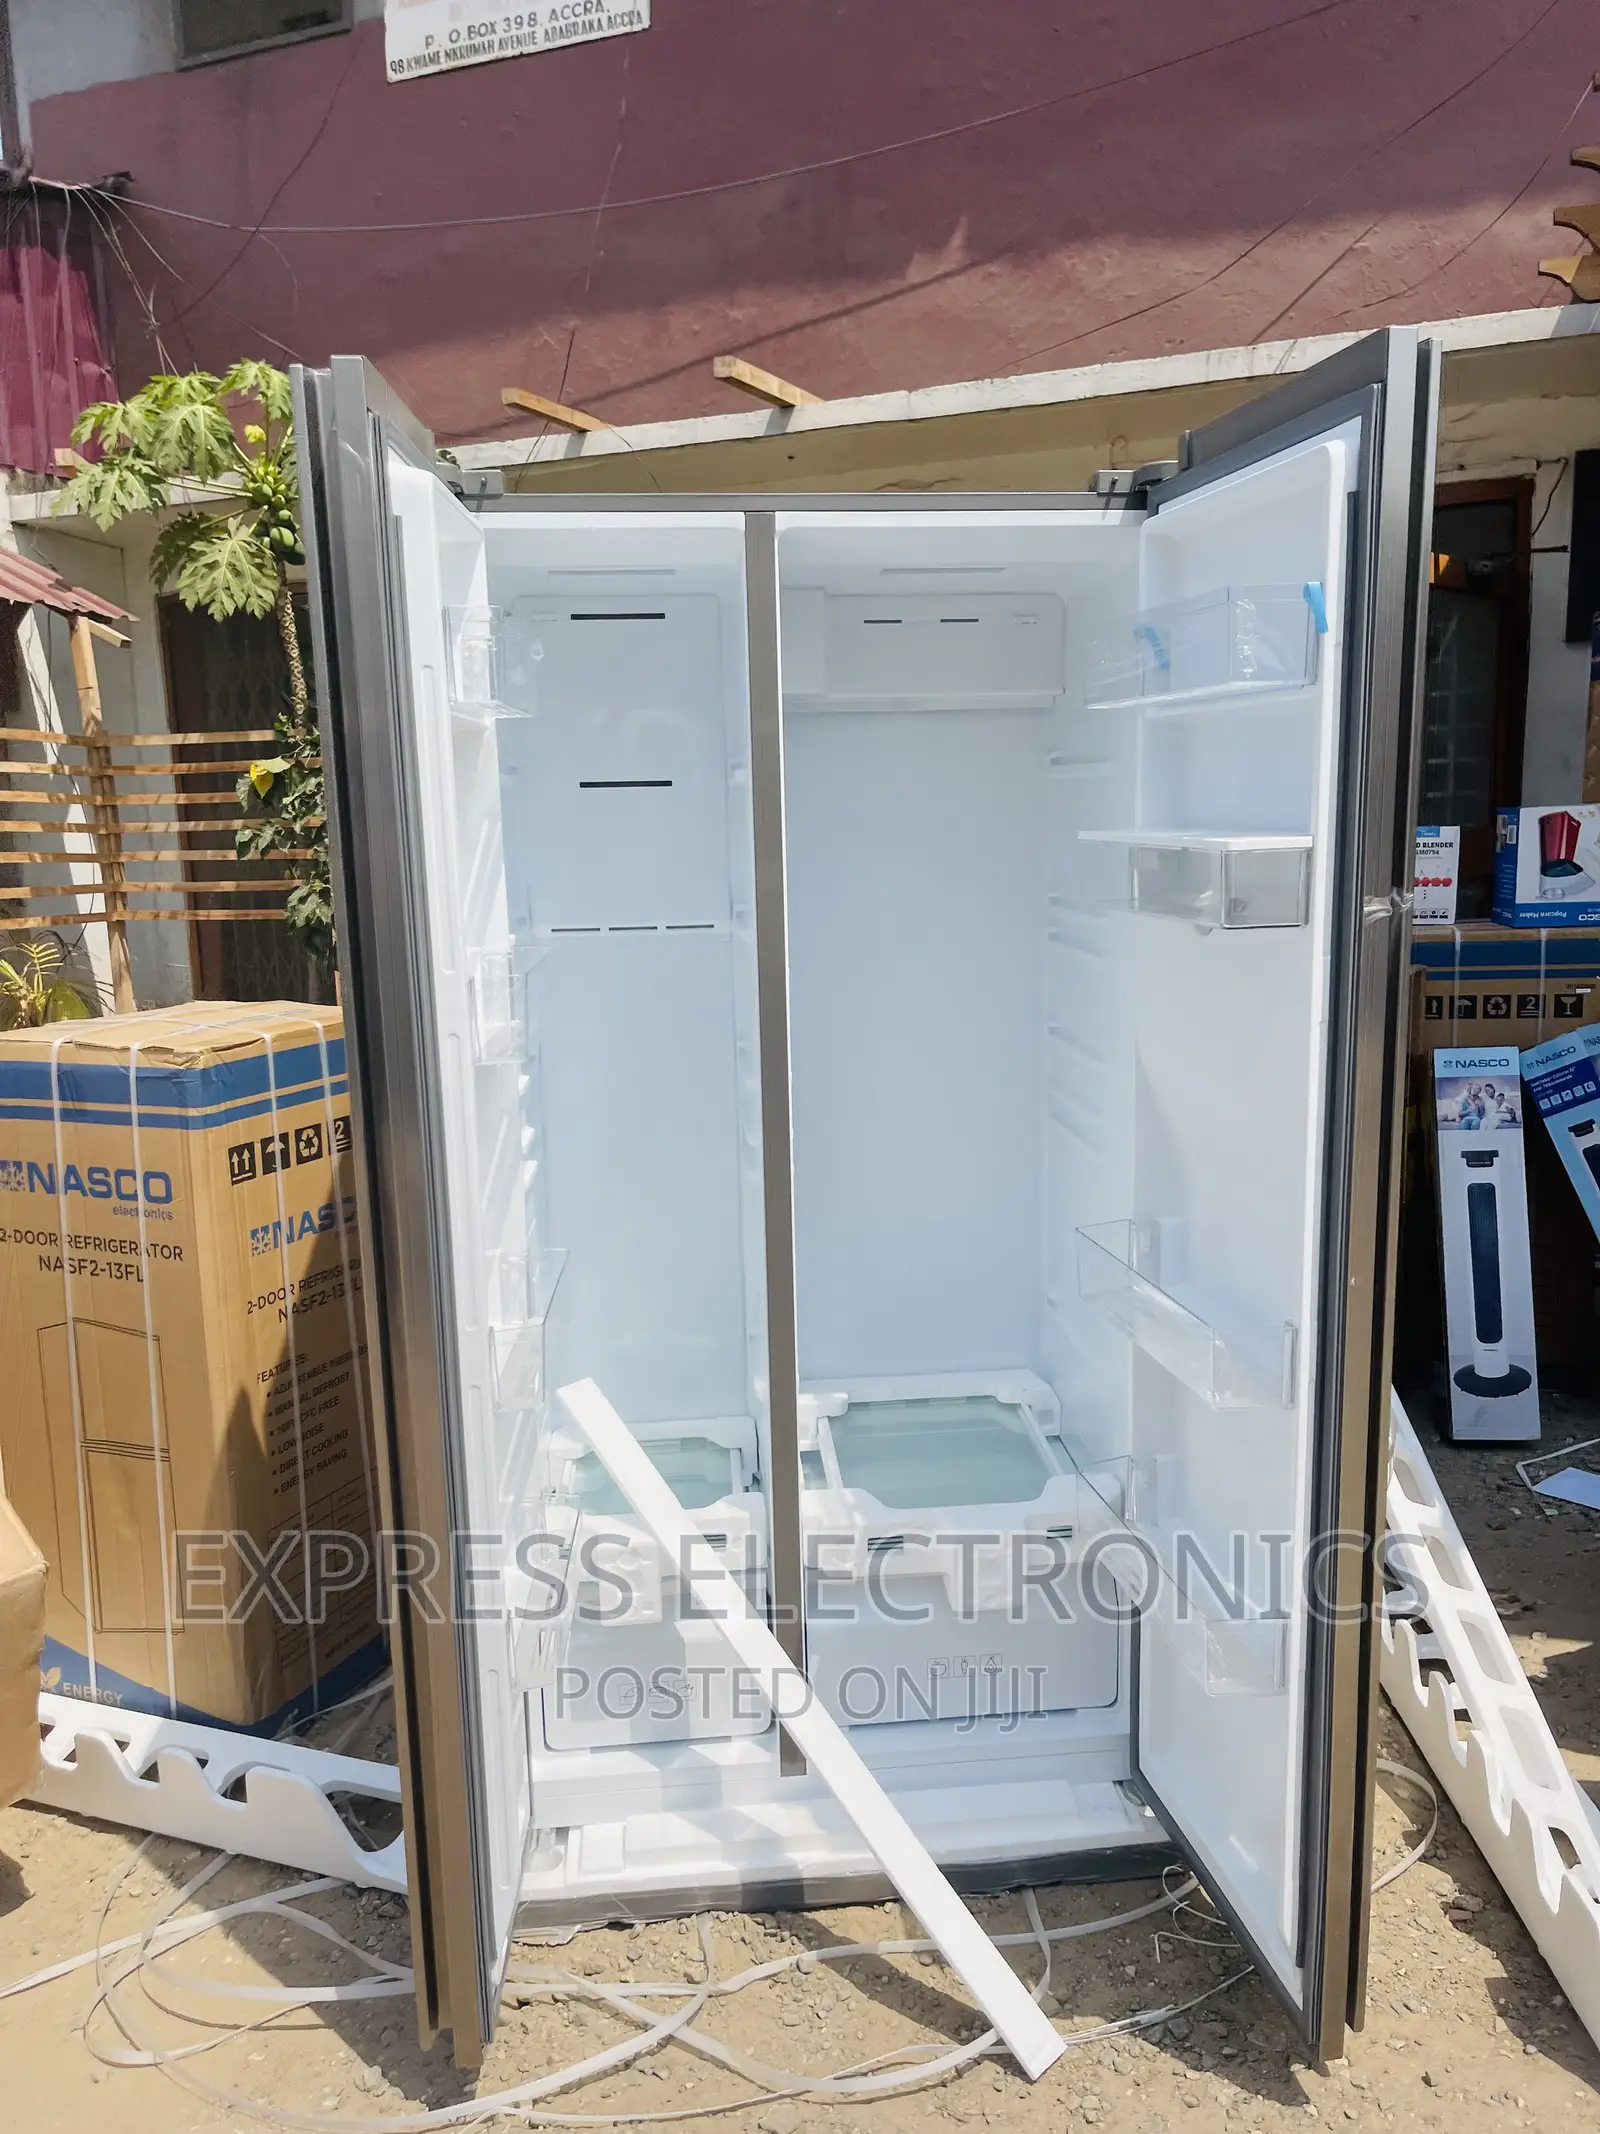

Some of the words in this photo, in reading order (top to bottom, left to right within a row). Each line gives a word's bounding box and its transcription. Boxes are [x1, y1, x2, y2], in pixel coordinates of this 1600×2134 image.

[390, 58, 406, 76] 98
[406, 51, 442, 73] KWAME
[444, 38, 496, 65] NKRUMAH
[497, 31, 539, 53] AVENUE
[543, 17, 605, 45] ADABRAKA
[606, 9, 644, 32] ACCRA
[1455, 1058, 1510, 1069] NASCO
[1535, 1046, 1577, 1067] NASCO
[26, 1161, 173, 1204] NASCO
[112, 1205, 174, 1221] electonics
[0, 1228, 60, 1248] 2-DOOR
[247, 1283, 295, 1315] 2-DOOR
[278, 1281, 362, 1323] NASF2-13L
[318, 1395, 341, 1415] FREE
[279, 1453, 311, 1474] DIRET
[312, 1429, 349, 1456] COOLING
[280, 1467, 316, 1494] ENEGY
[317, 1449, 348, 1471] SAVING
[62, 1681, 124, 1707] ENERGY
